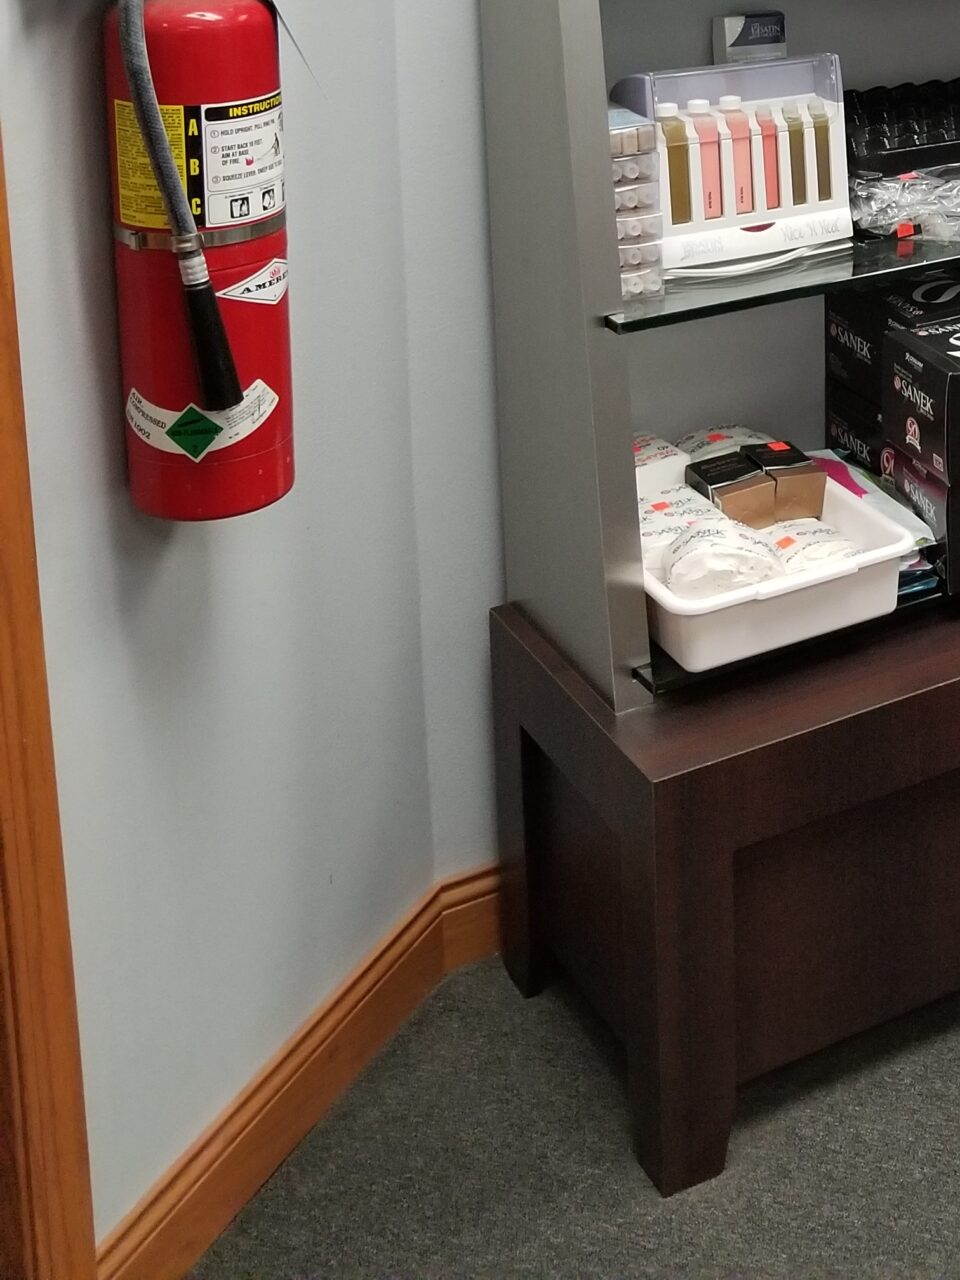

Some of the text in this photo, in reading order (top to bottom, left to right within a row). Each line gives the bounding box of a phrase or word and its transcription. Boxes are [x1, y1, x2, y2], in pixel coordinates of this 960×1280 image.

[229, 95, 282, 117] INSTRUCTIO
[188, 119, 198, 136] A
[190, 158, 199, 176] B
[191, 198, 200, 215] C
[240, 270, 288, 294] AMERE
[837, 324, 871, 359] SANEK
[901, 380, 934, 415] SANEK
[134, 422, 151, 440] 1002
[838, 428, 870, 462] SANEK
[910, 484, 936, 521] SANEK
